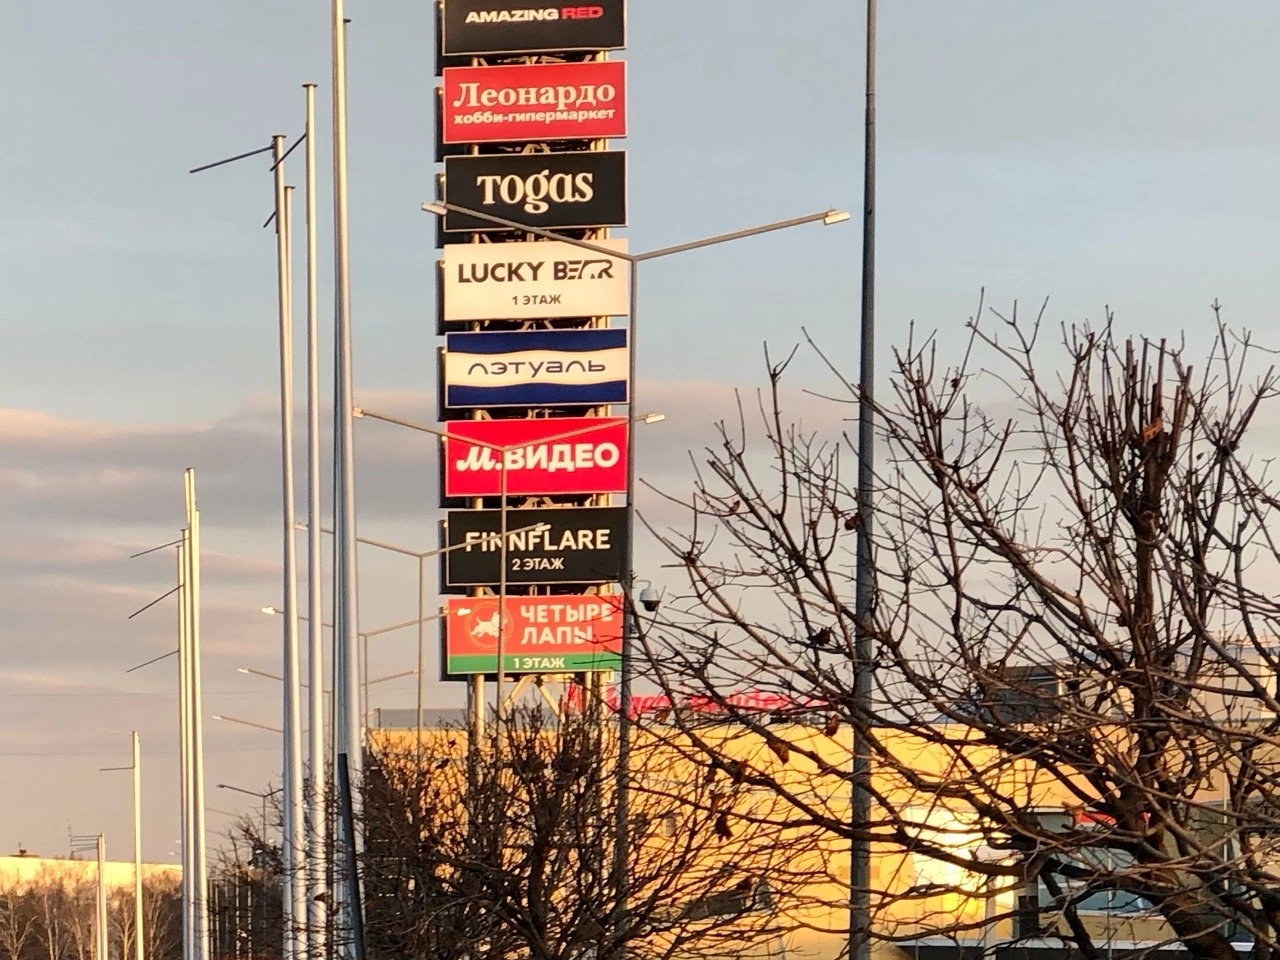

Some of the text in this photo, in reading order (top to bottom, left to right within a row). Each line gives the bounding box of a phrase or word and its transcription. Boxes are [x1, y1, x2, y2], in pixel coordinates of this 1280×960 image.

[465, 6, 604, 23] AMAZING RED
[452, 82, 616, 111] Леонардо
[452, 108, 616, 126] хобби-гипермаркет
[457, 261, 545, 283] LUCKY
[512, 294, 562, 306] 1 ЭТАЖ
[465, 528, 611, 552] FINNFLARE
[512, 557, 564, 571] 2 ЭТАЖ
[520, 603, 614, 623] ЧЕТЫРЕ
[520, 626, 594, 646] ЛАПЫ
[513, 656, 565, 669] 1 ЭТАЖ
